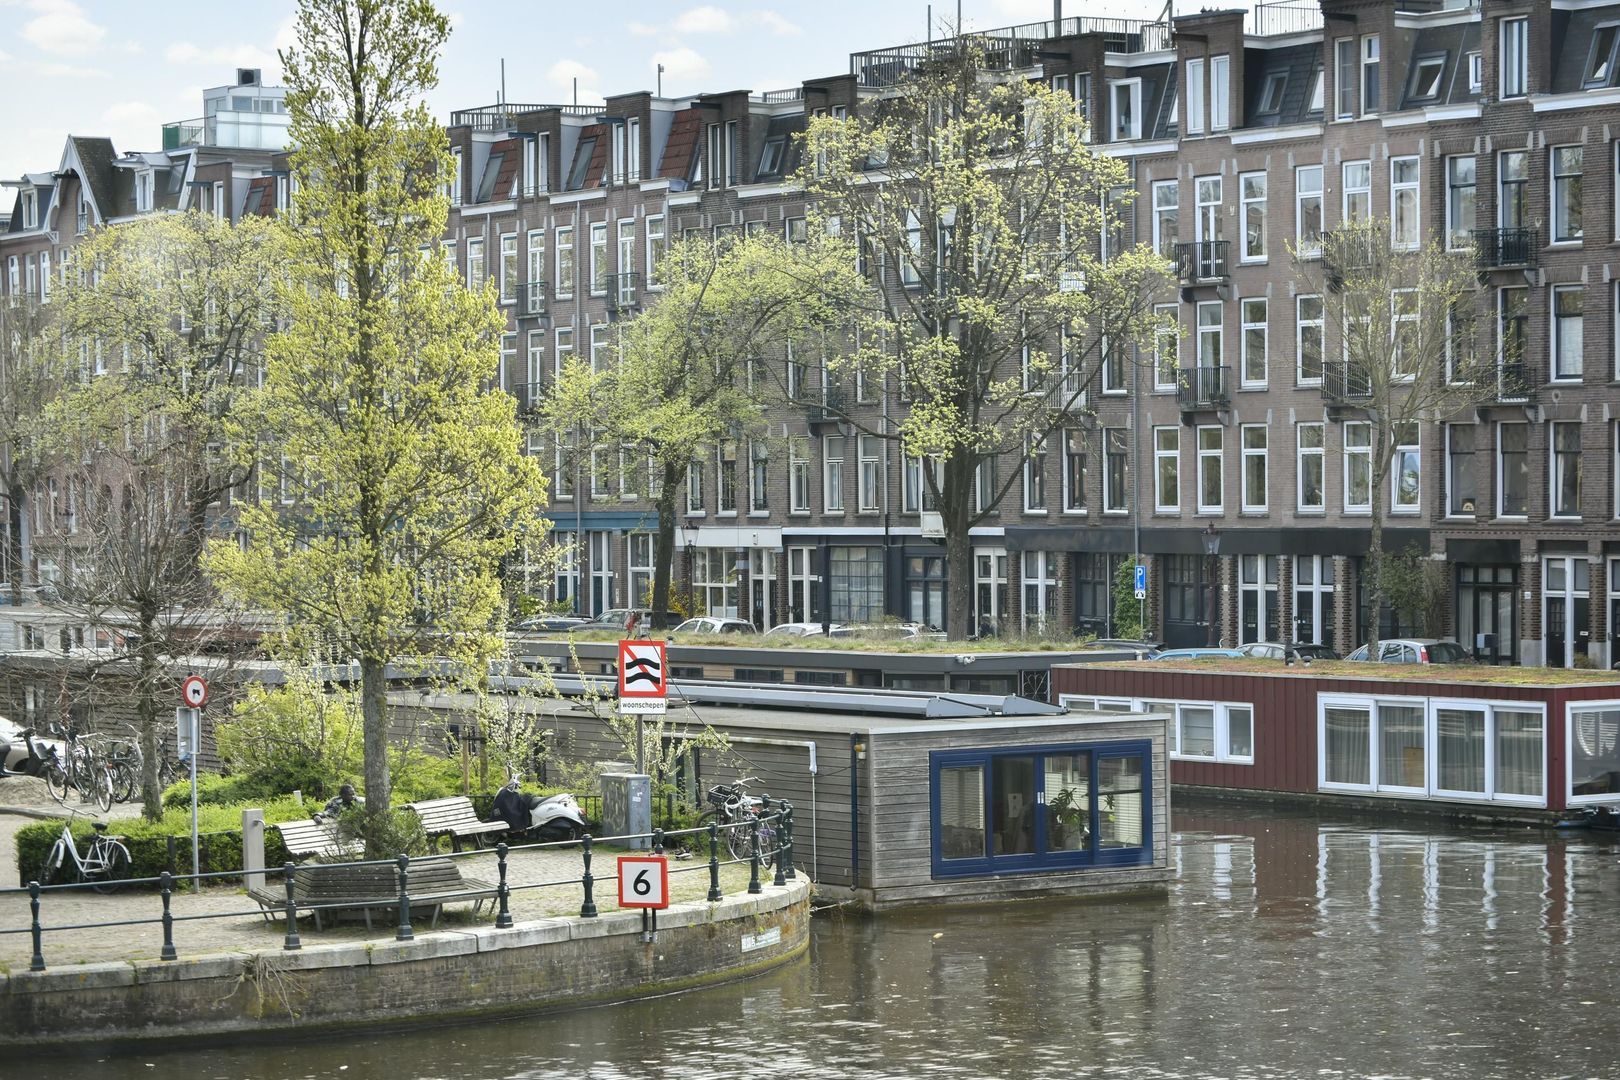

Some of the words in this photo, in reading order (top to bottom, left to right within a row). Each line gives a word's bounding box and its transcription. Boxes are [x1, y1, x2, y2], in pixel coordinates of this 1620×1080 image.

[1137, 568, 1143, 580] P
[622, 701, 664, 710] woonschepen
[633, 869, 651, 896] 6
